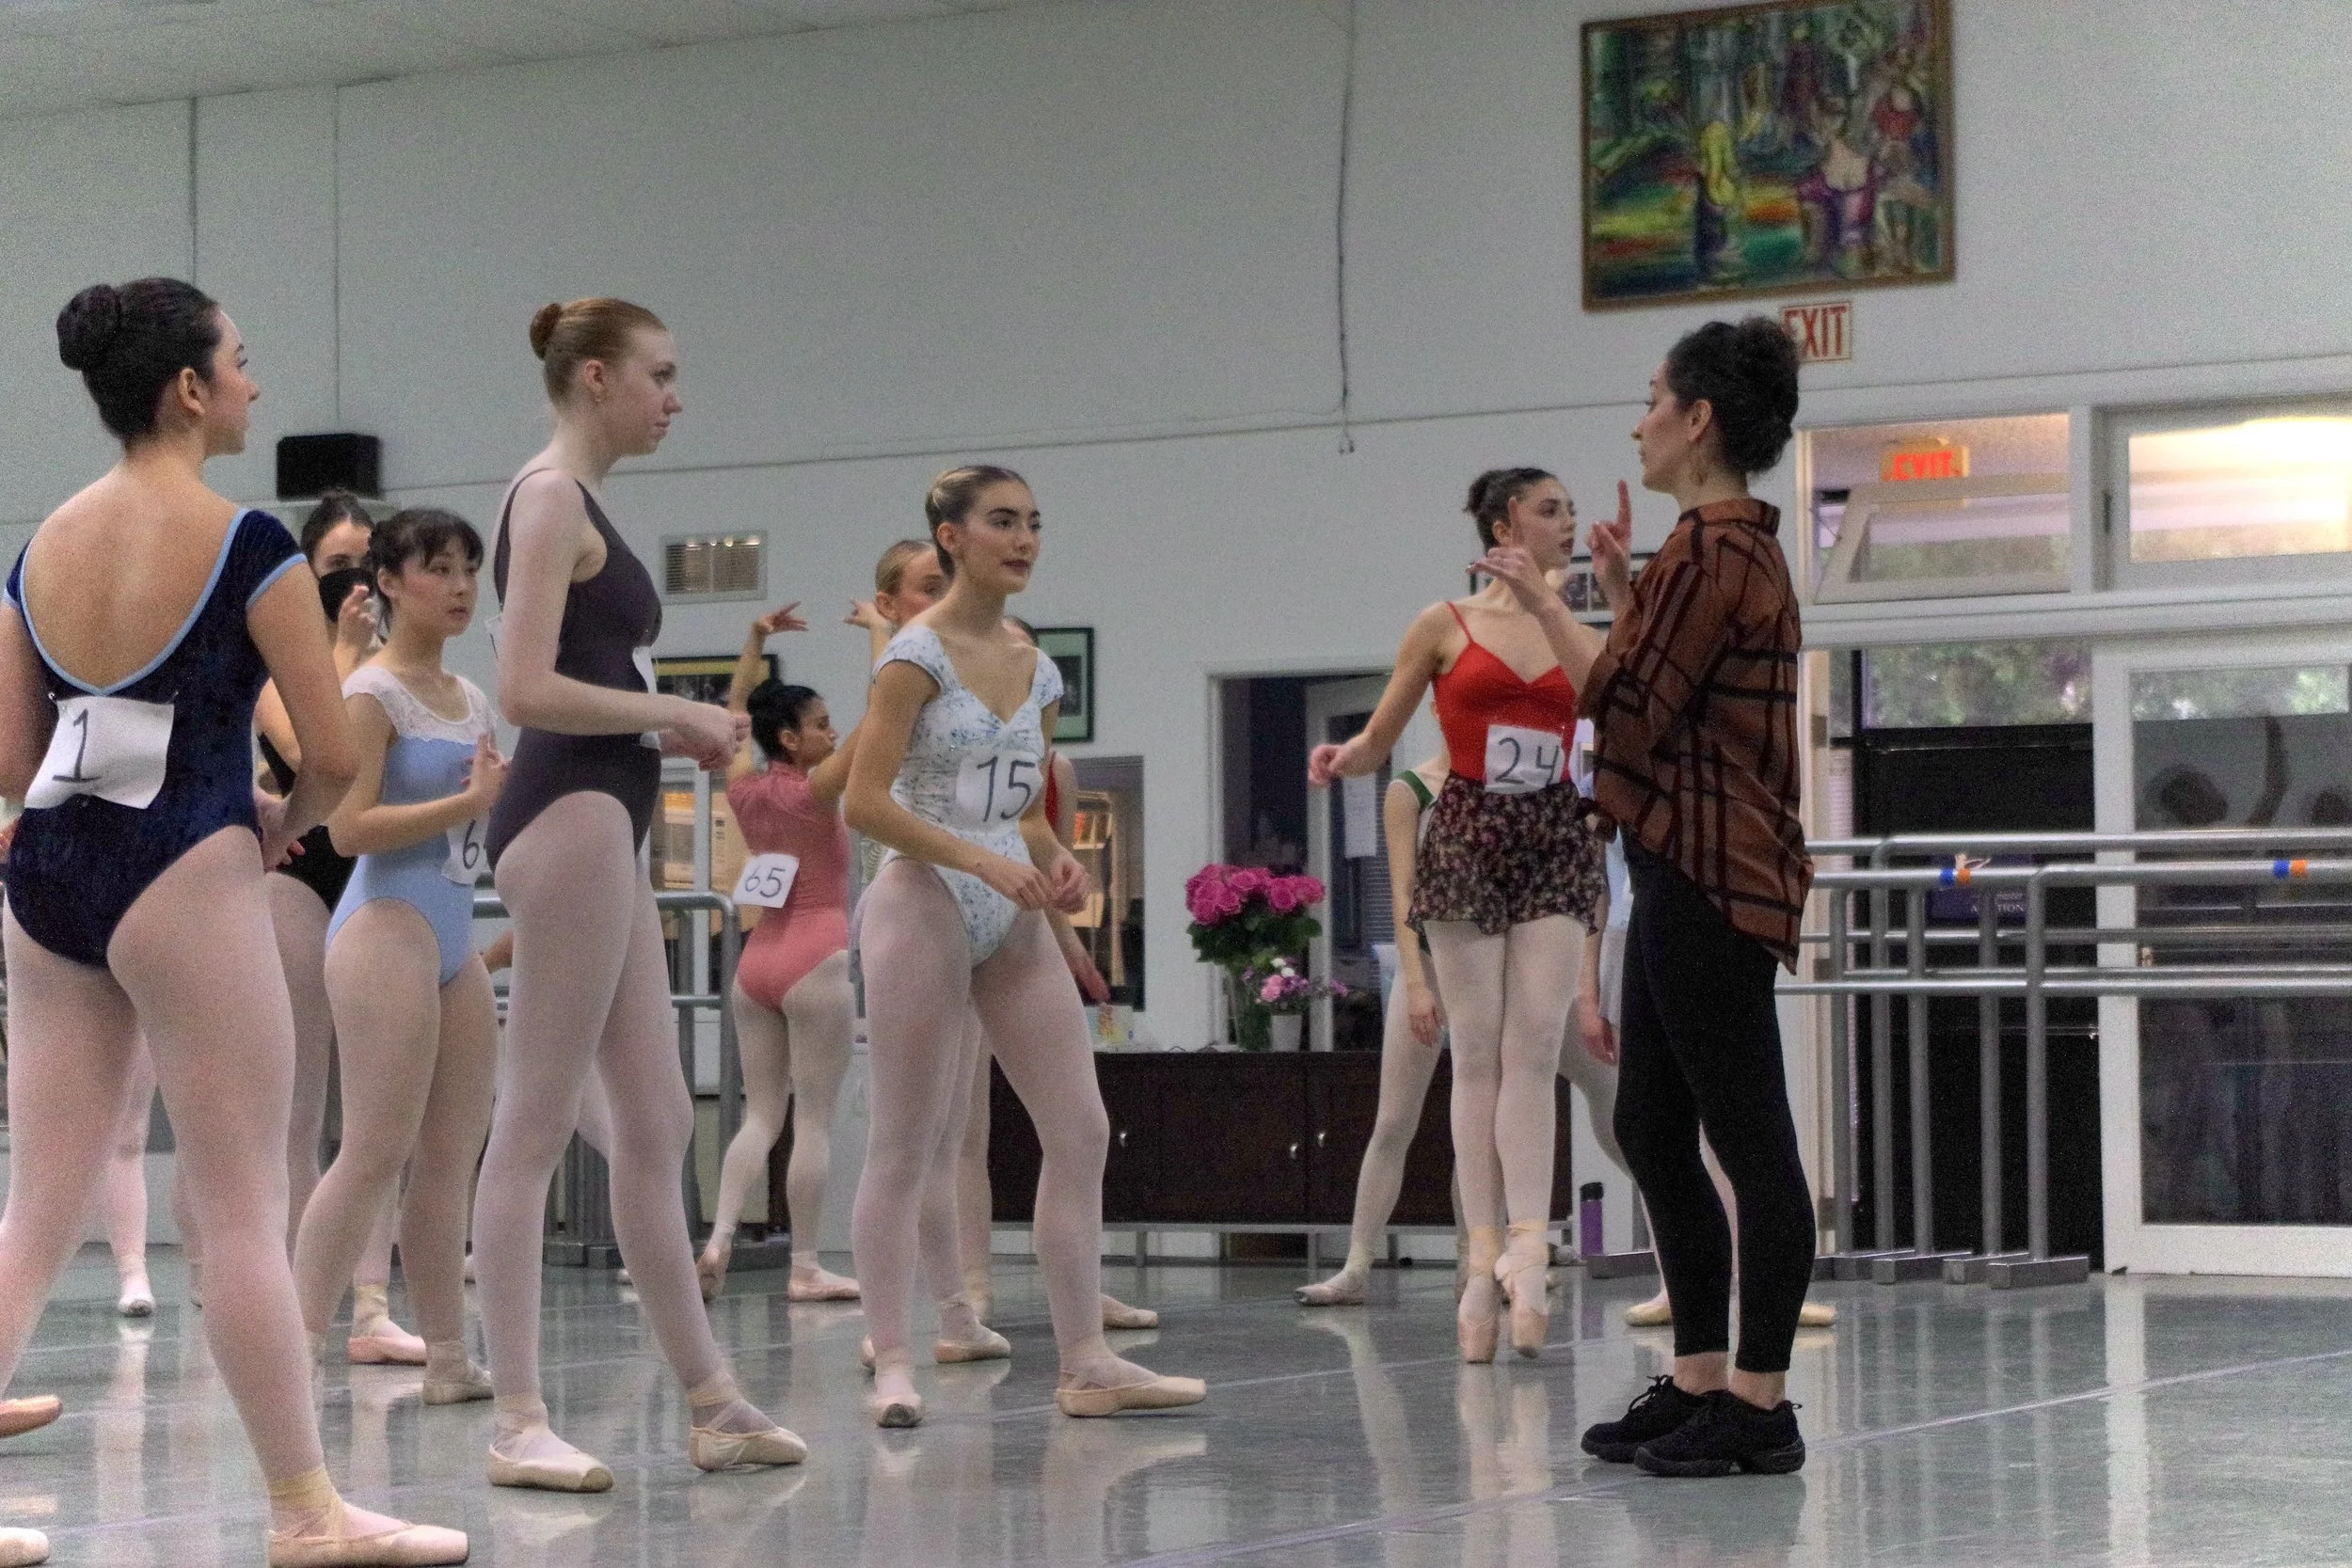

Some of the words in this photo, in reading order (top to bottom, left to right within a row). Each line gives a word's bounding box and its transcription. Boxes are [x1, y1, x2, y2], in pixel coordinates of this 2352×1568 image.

[1784, 306, 1847, 357] EXIT
[52, 708, 103, 783] 1
[1494, 736, 1560, 788] 24
[977, 755, 1036, 823] 15
[463, 819, 480, 870] 6
[744, 864, 787, 898] 65
